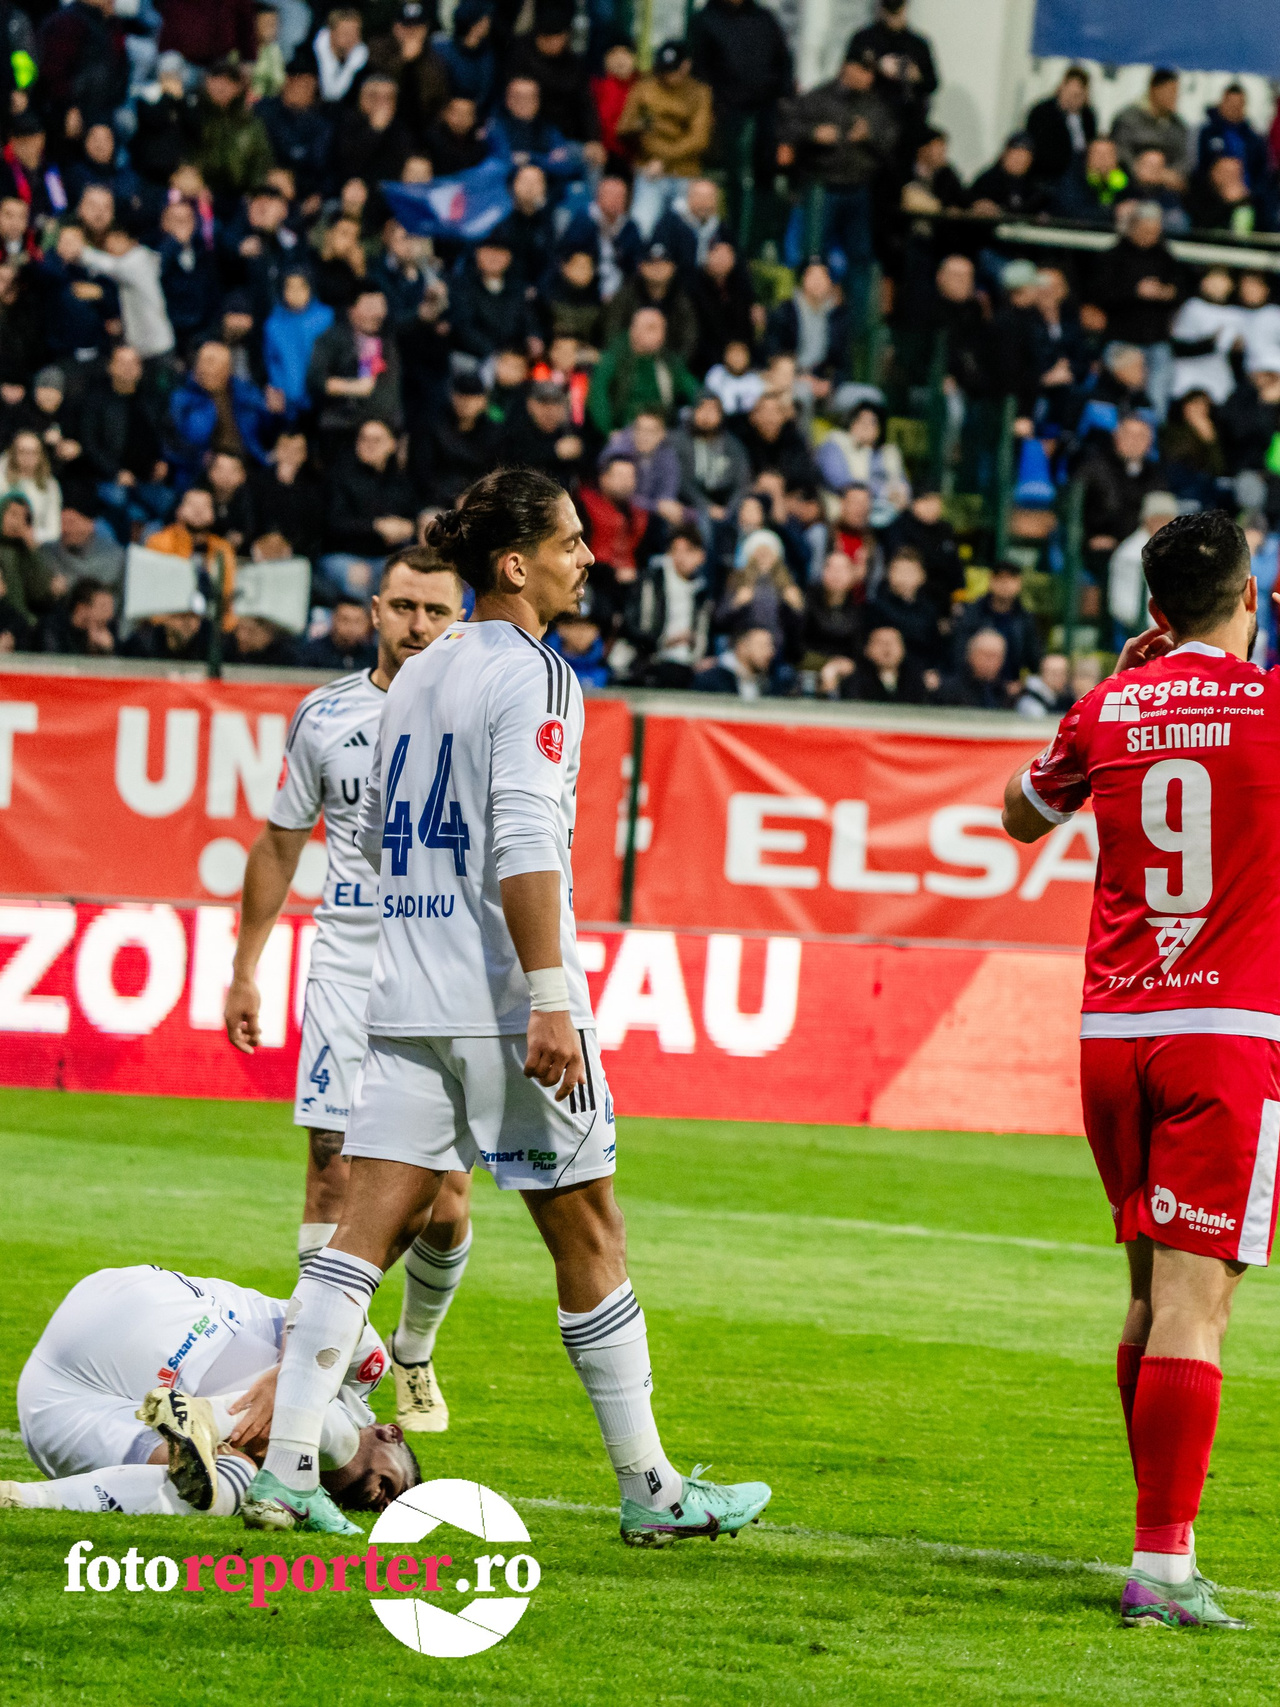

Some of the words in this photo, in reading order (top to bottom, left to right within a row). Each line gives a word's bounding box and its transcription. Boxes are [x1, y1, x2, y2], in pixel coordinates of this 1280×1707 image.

[1120, 677, 1265, 707] Regata.ro
[1140, 708, 1168, 719] Gresie
[1223, 706, 1265, 716] Parchet
[1126, 722, 1231, 753] SELMANI
[382, 732, 470, 877] 44
[1141, 758, 1213, 914] 9
[383, 894, 455, 918] SADIKU
[310, 1045, 330, 1094] 4
[479, 1149, 525, 1163] Smart
[527, 1148, 557, 1162] Eco
[532, 1160, 557, 1171] Plus
[1178, 1202, 1237, 1231] Tehnic
[1188, 1223, 1221, 1236] GROUP
[167, 1332, 198, 1371] Smart
[192, 1315, 210, 1336] Eco
[204, 1323, 219, 1339] Plus
